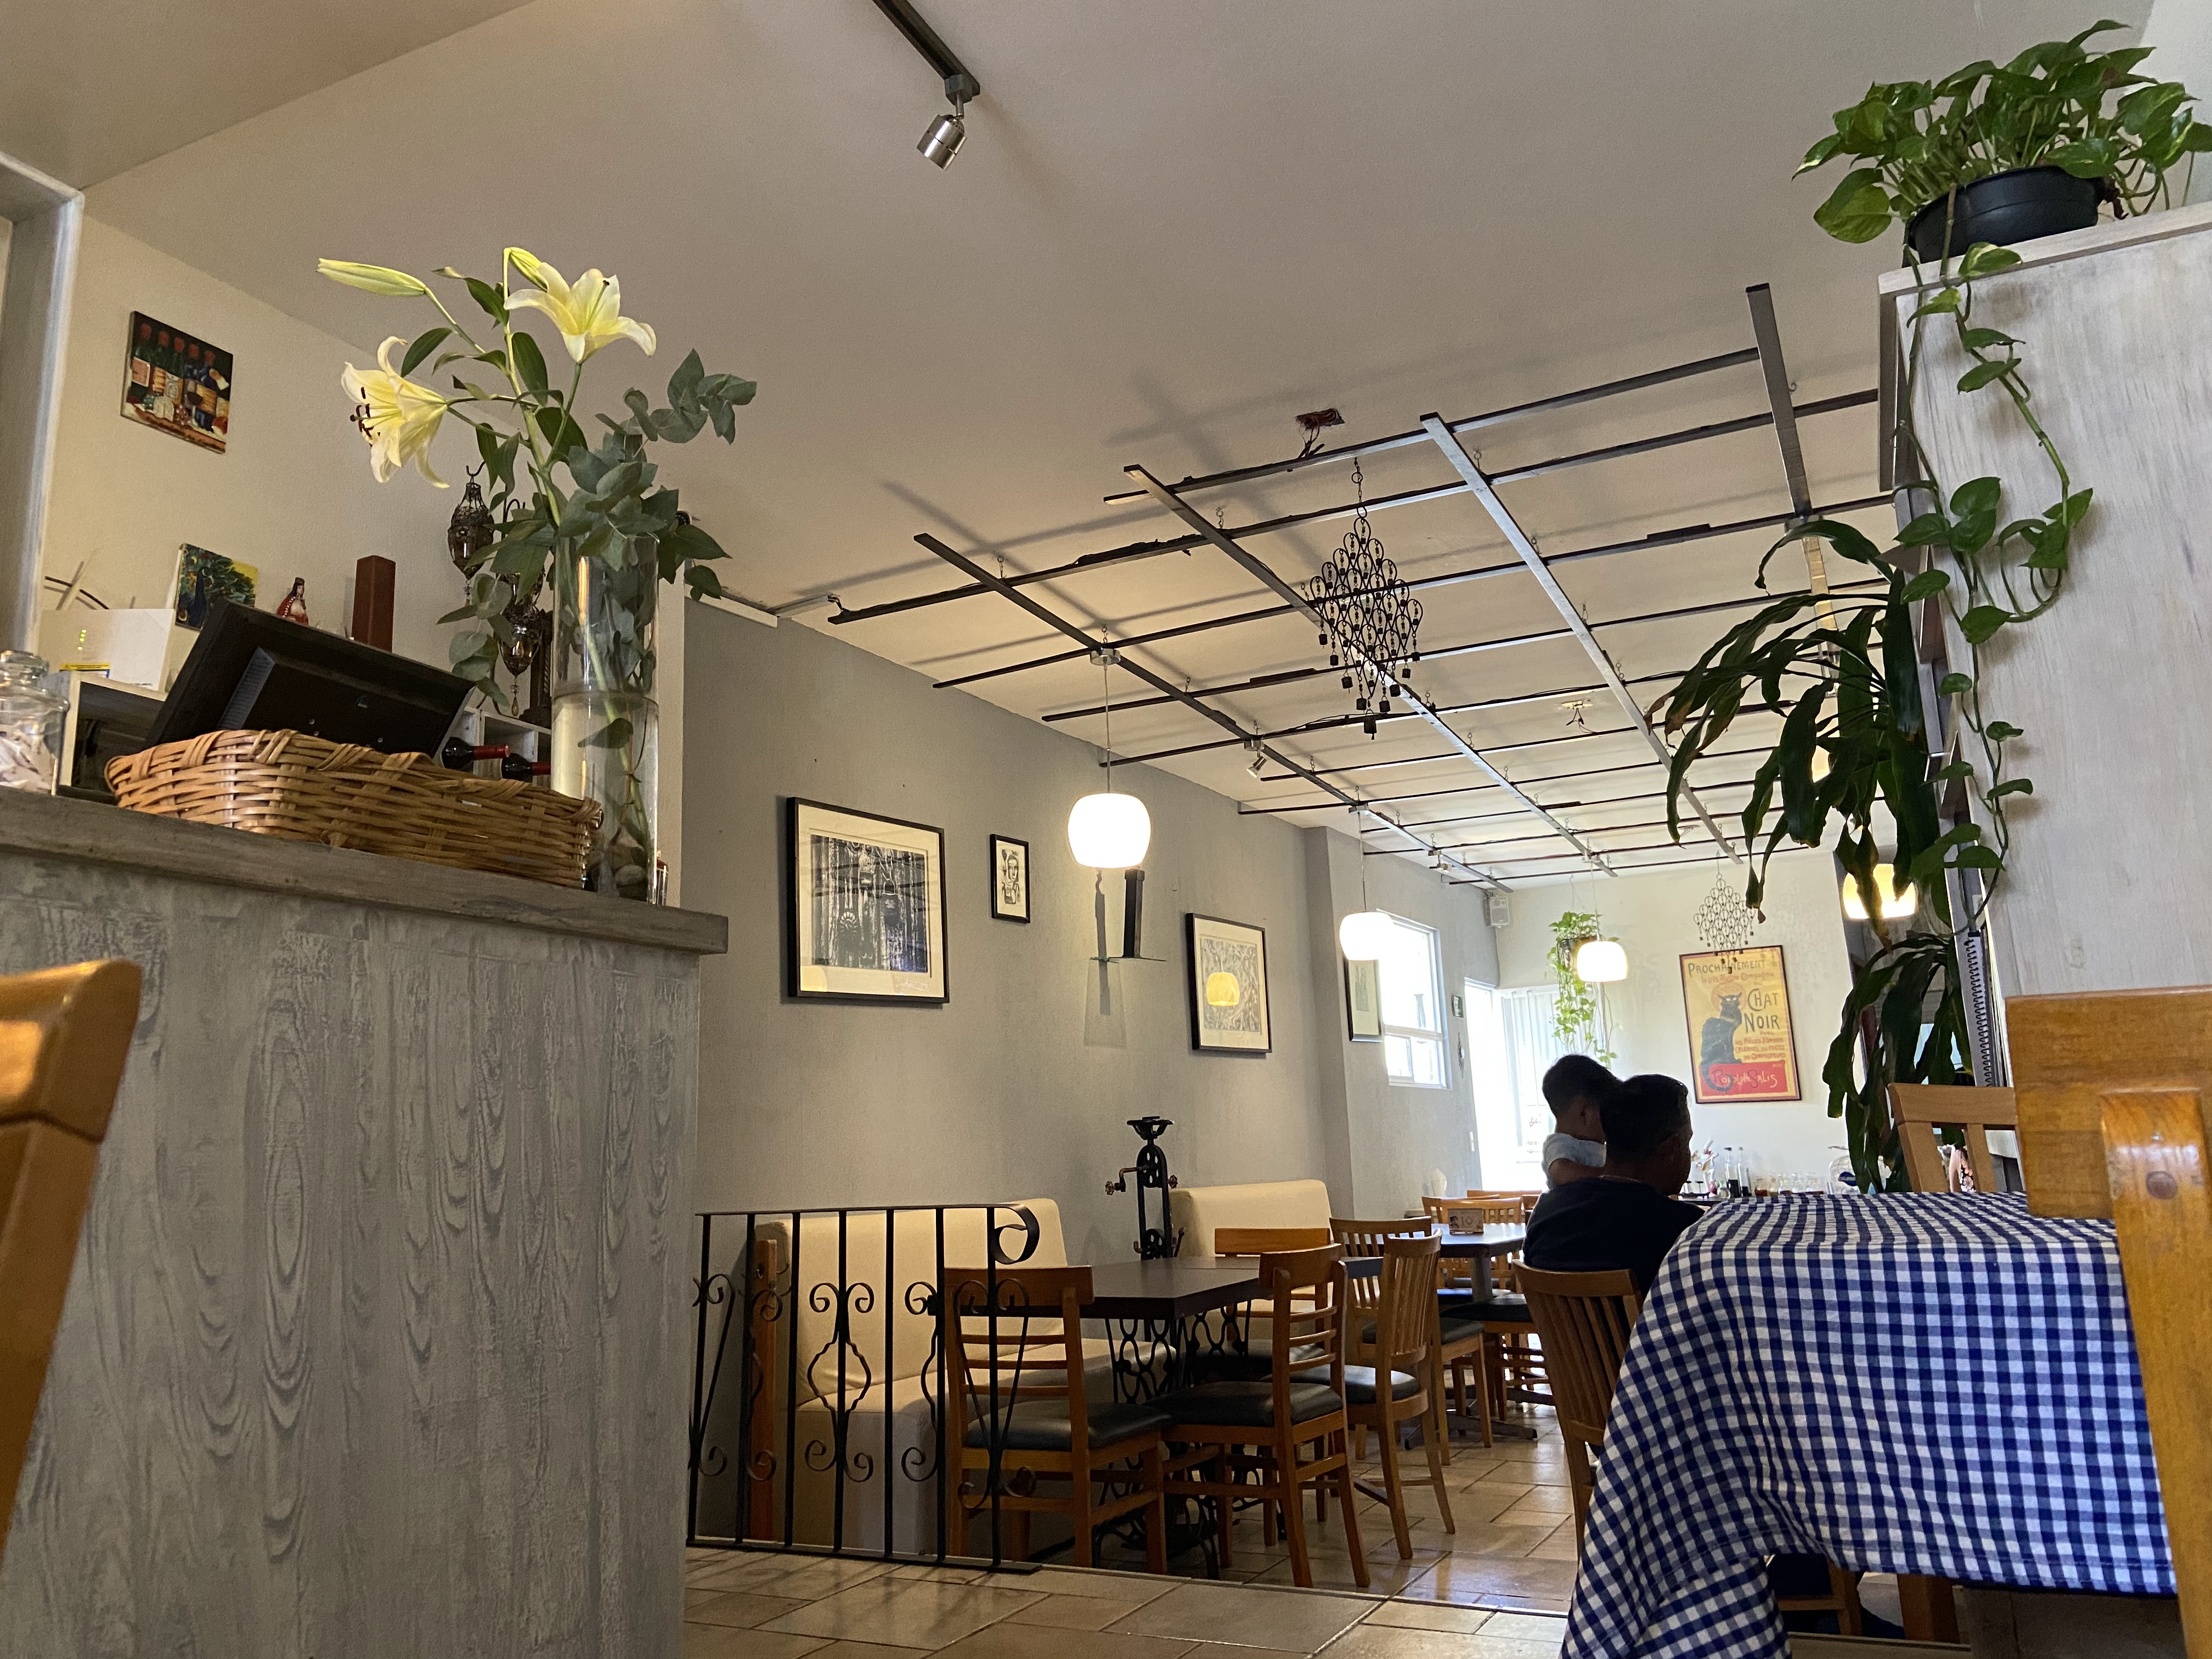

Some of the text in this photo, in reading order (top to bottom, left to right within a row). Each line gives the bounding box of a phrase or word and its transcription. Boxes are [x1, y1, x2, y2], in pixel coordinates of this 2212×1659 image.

[1688, 960, 1765, 978] PROCHANEMENT
[1747, 988, 1778, 1011] CHAT
[1743, 1013, 1780, 1033] NOIR
